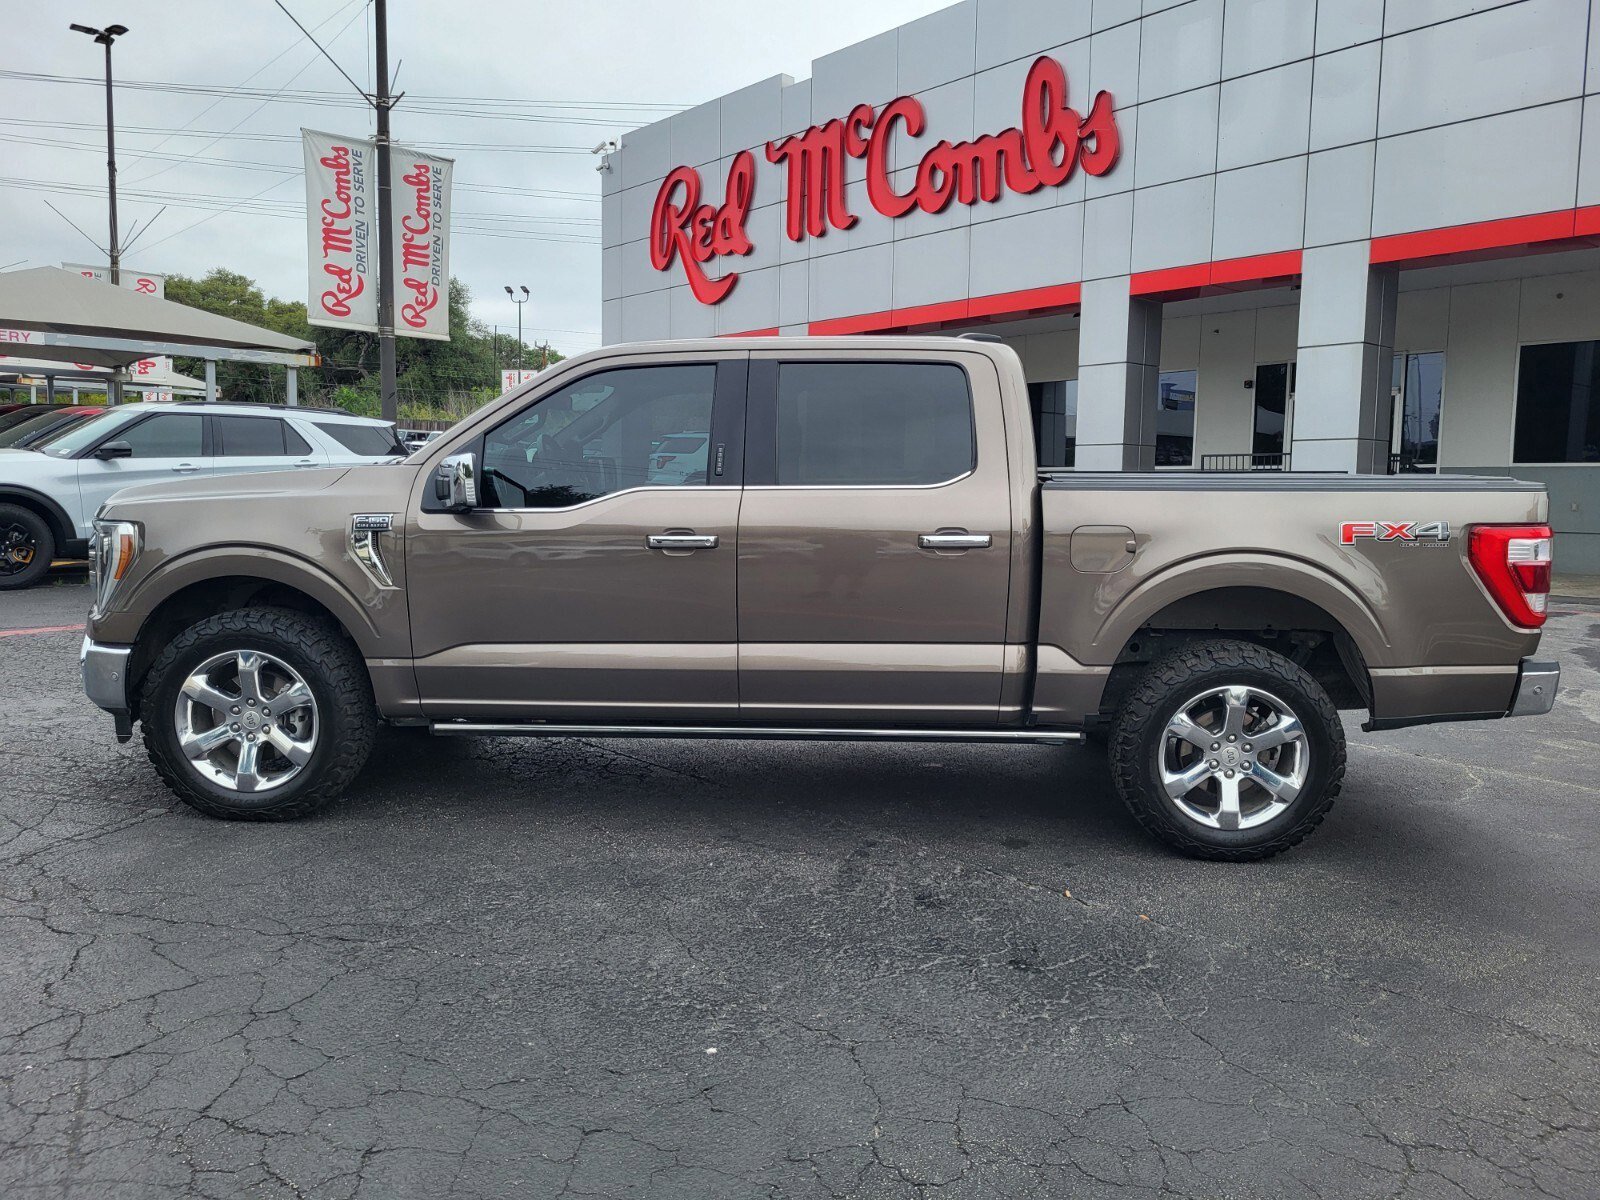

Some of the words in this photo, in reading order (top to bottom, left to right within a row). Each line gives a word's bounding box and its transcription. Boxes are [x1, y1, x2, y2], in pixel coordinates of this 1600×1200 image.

[351, 149, 365, 193] SERVE
[431, 166, 443, 209] SERVE
[650, 150, 755, 305] Red
[766, 55, 1121, 242] McCombs
[320, 145, 353, 258] McCombs
[354, 196, 365, 217] TO
[402, 163, 431, 273] McCombs
[431, 212, 442, 231] TO
[355, 219, 367, 274] DRIVEN
[431, 235, 442, 286] DRIVEN
[321, 263, 364, 317] Red
[401, 277, 438, 328] Red
[1339, 520, 1450, 547] FX4
